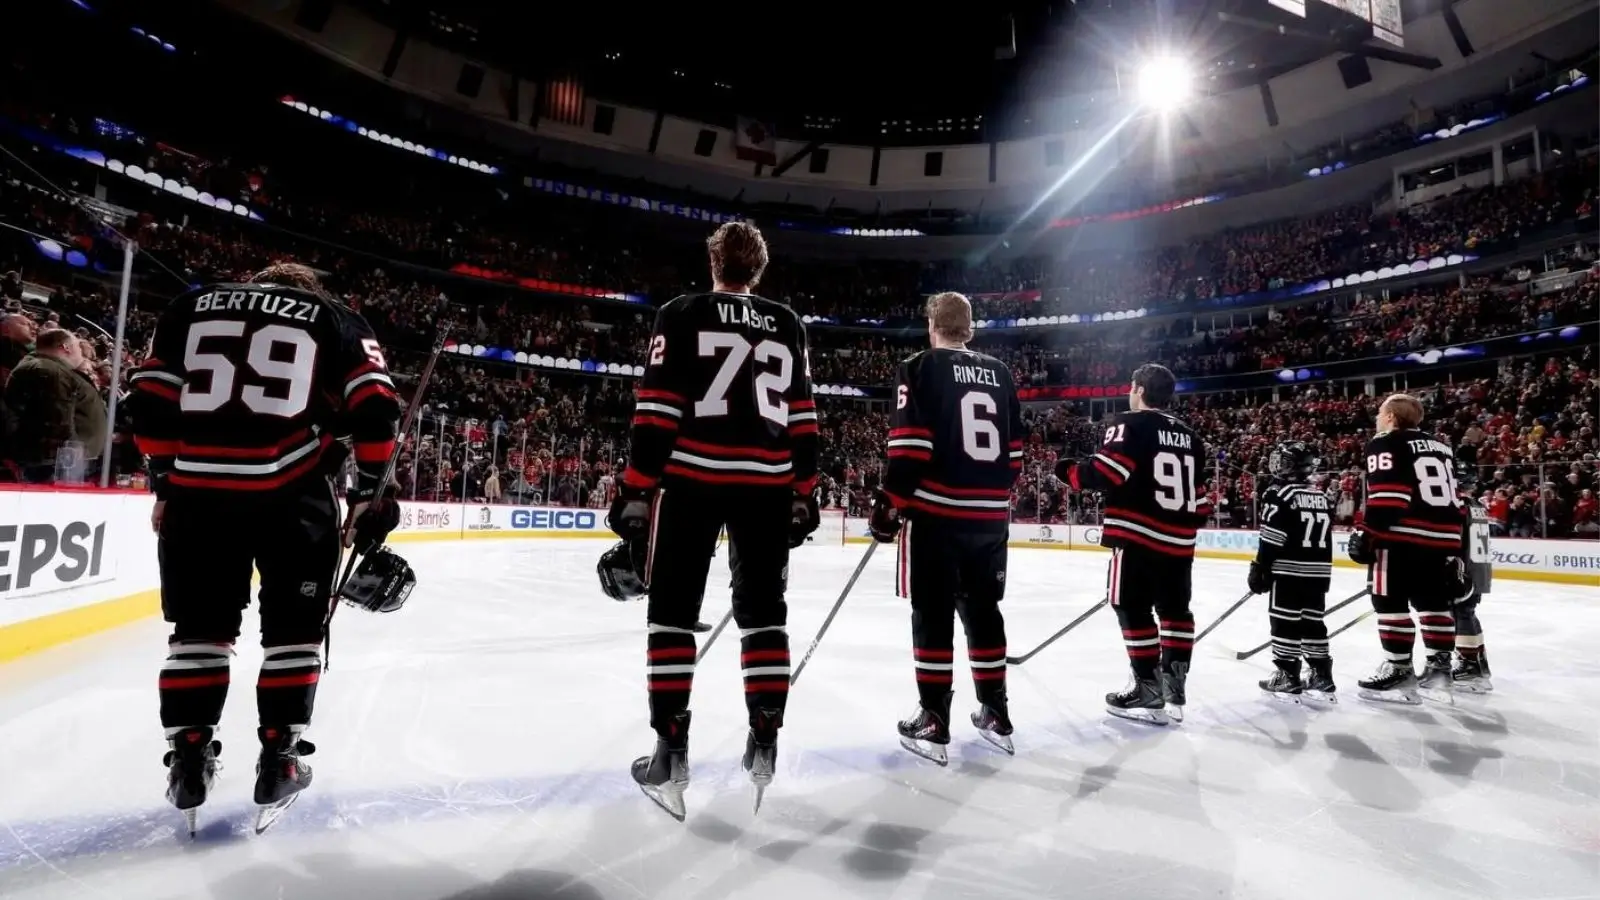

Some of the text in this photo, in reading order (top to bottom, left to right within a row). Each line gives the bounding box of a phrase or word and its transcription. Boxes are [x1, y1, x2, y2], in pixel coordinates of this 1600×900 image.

[194, 291, 321, 323] BERTUZZI
[717, 302, 777, 332] VLASIC
[179, 319, 318, 418] 59
[694, 331, 794, 428] 72
[953, 365, 1000, 387] RINZEL
[896, 384, 909, 411] 6
[960, 391, 1001, 463] 6
[1103, 424, 1125, 445] 91
[1157, 430, 1192, 449] NAZAR
[1366, 451, 1394, 475] 86
[1153, 451, 1196, 512] 91
[511, 510, 596, 529] GEICO
[1300, 510, 1331, 549] 77
